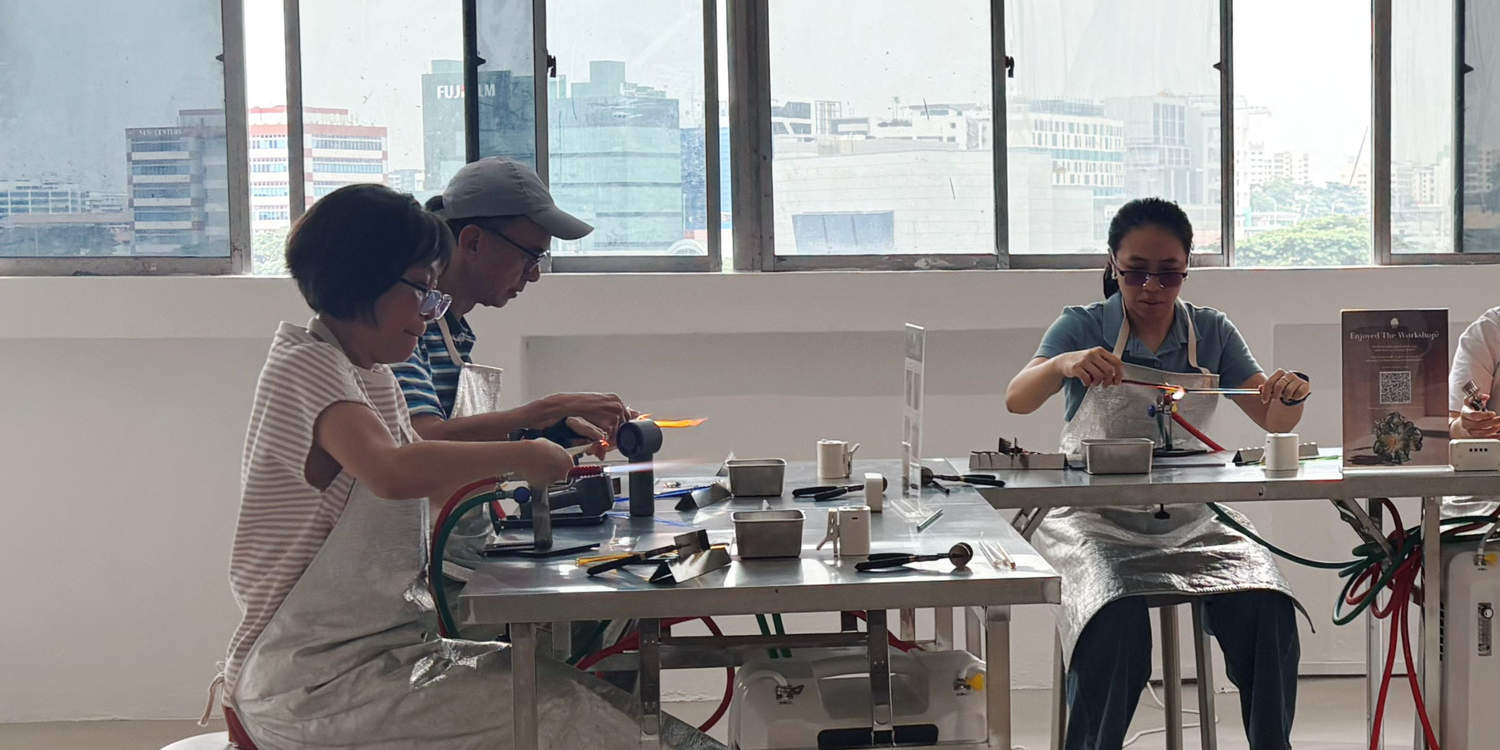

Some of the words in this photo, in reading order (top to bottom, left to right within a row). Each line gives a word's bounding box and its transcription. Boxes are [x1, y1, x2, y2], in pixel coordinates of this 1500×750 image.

[436, 84, 496, 99] FUJILM
[1350, 331, 1380, 342] Enjoyed
[1382, 331, 1397, 340] The
[1398, 330, 1440, 341] Workshop?
